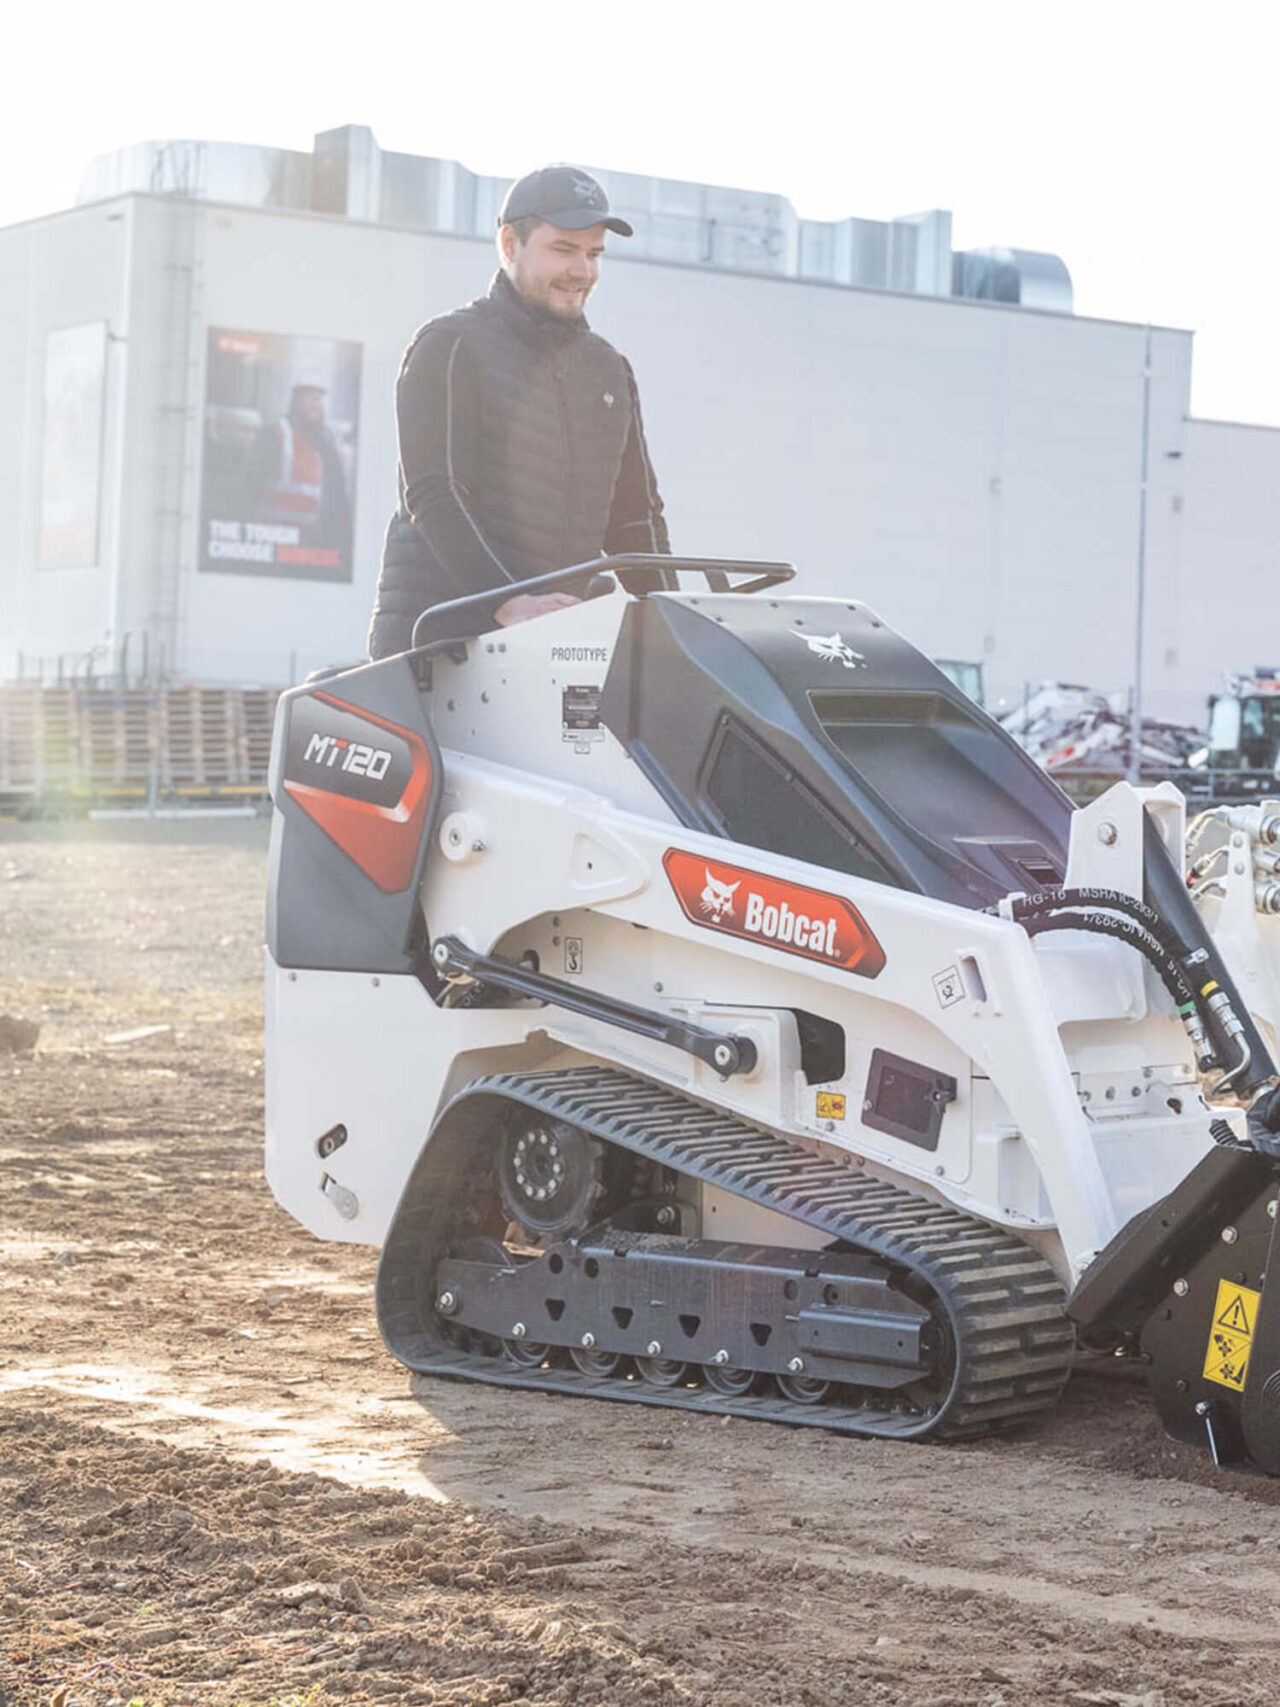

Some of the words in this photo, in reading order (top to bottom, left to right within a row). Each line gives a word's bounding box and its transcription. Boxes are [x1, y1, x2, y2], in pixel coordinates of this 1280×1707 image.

[551, 646, 607, 662] PROTOTYPE
[303, 732, 393, 781] MT120
[744, 892, 837, 957] Bobcat
